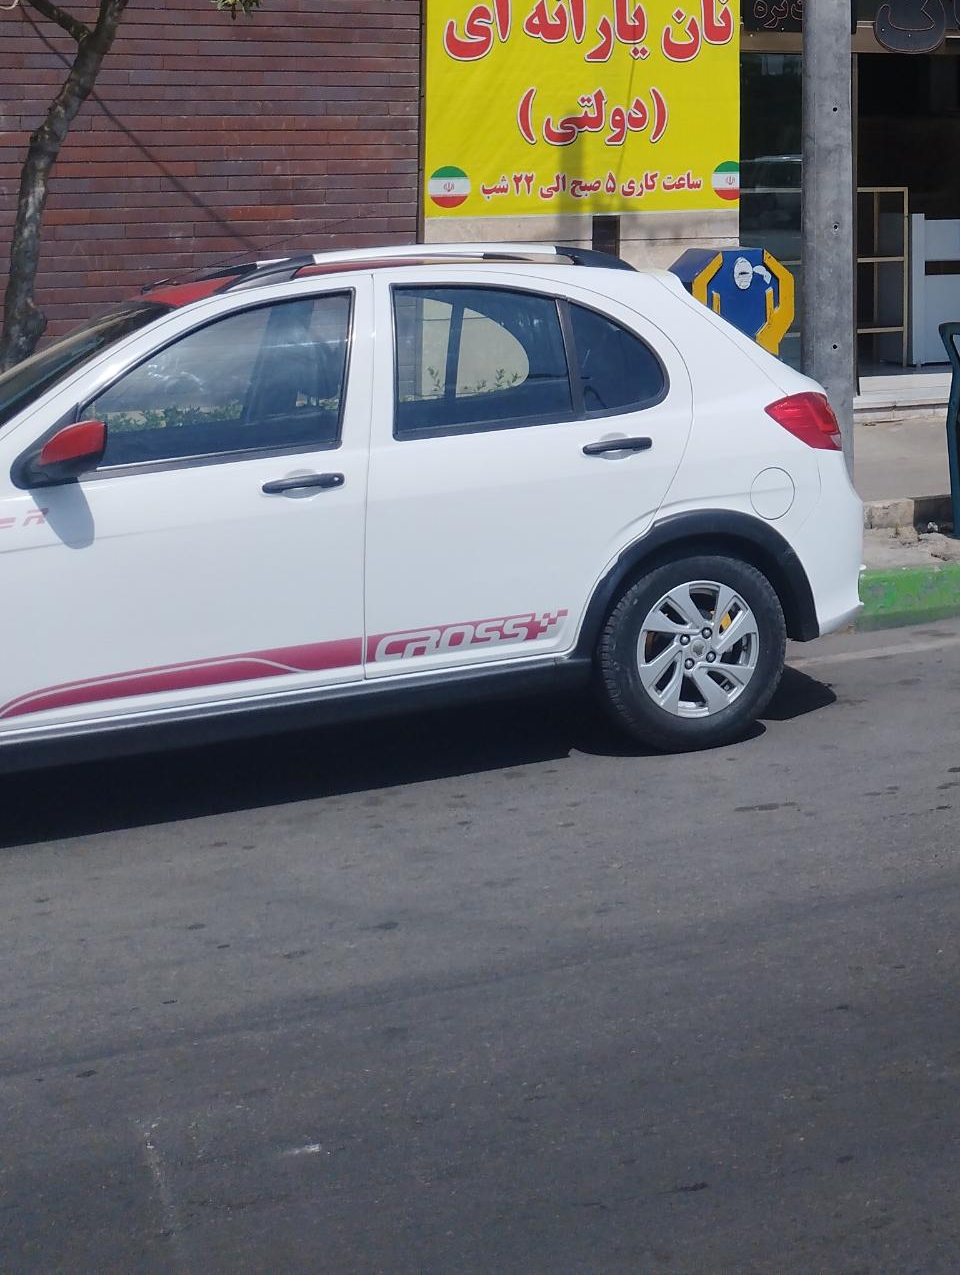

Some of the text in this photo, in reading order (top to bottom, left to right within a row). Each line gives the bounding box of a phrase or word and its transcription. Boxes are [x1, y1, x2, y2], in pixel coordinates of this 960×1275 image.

[517, 87, 667, 144] (دولتی)
[480, 171, 702, 200] ساعت کاری ۵ صبح الی ۲۲ شب
[374, 613, 534, 663] CROSS
